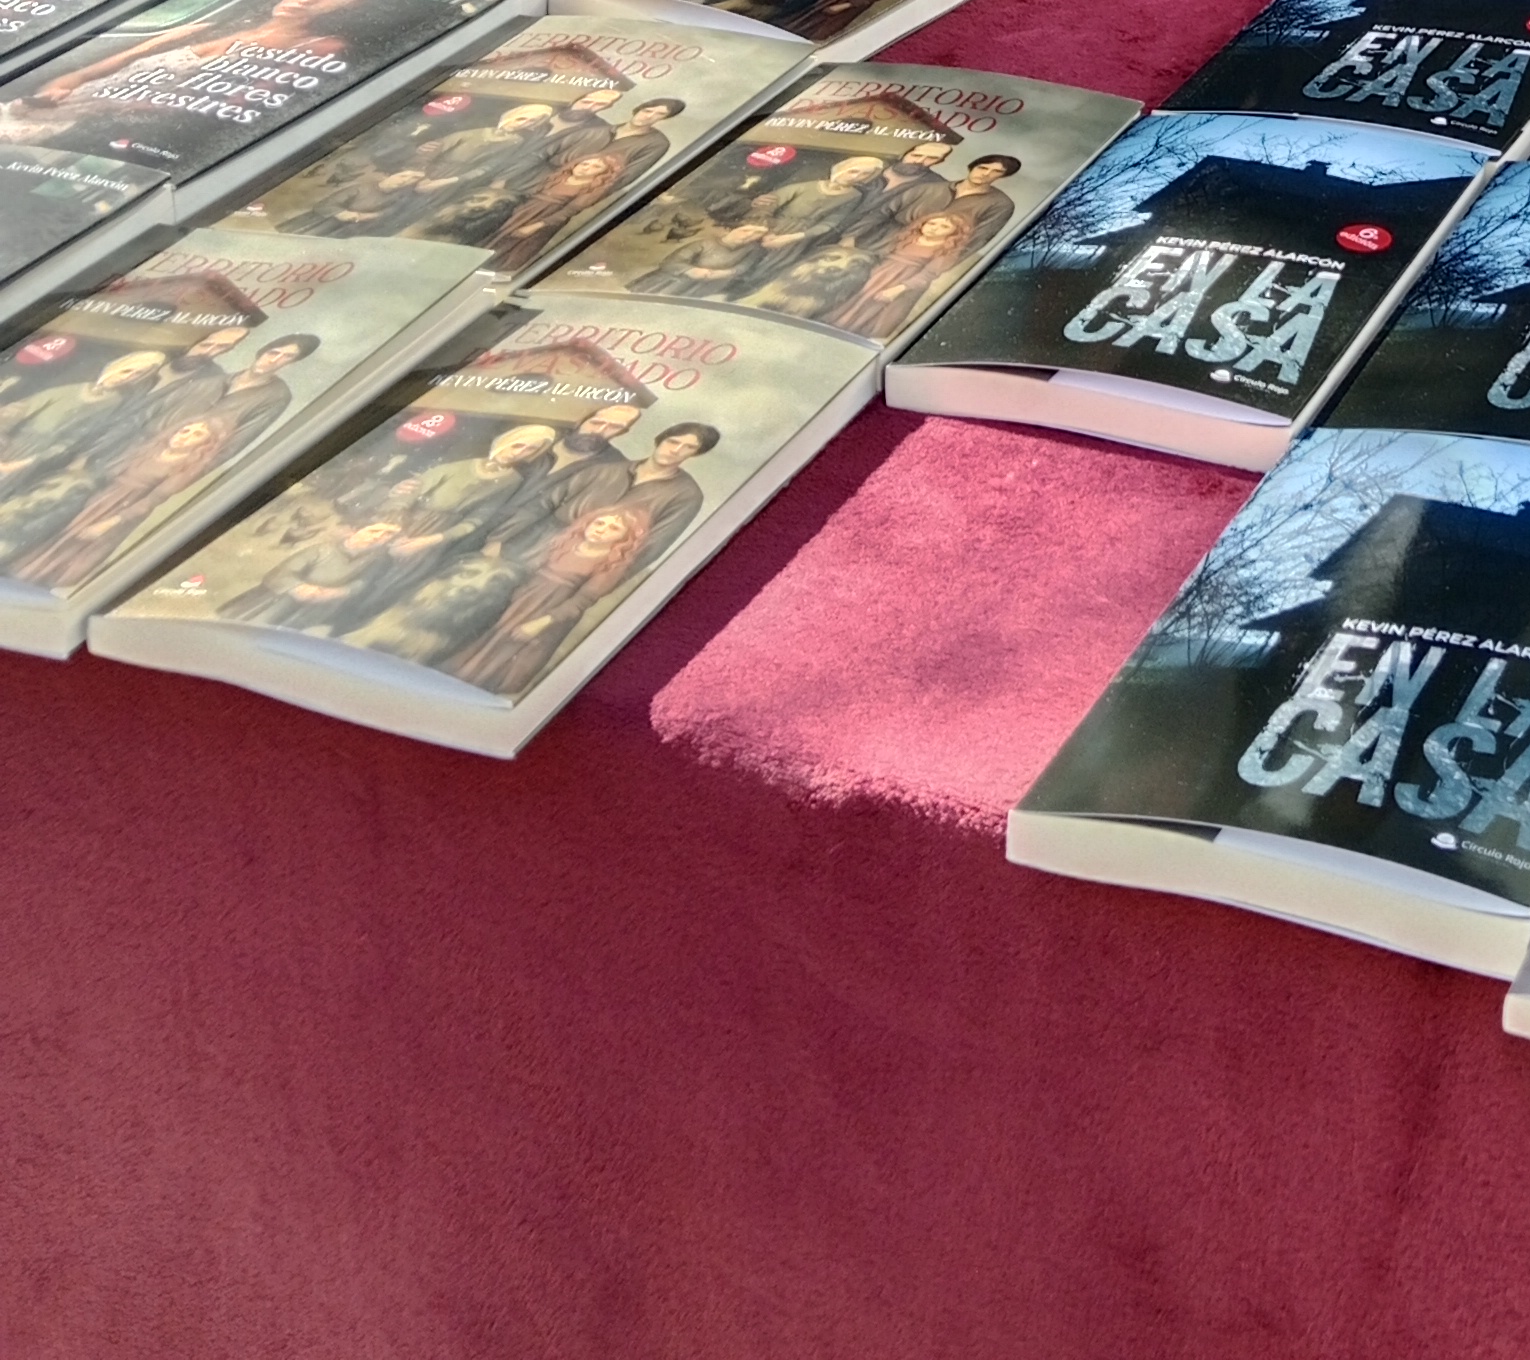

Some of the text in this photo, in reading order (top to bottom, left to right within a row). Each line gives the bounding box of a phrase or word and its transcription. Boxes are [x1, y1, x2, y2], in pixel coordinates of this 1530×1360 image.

[1372, 23, 1417, 34] KEVIN
[226, 39, 349, 75] Vestido
[1349, 31, 1443, 67] EN
[128, 67, 291, 109] de flores
[201, 56, 320, 91] blanco
[92, 82, 261, 125] silvestres
[815, 80, 1024, 116] TERRITORIO
[1302, 60, 1525, 128] CASA
[765, 116, 947, 143] KEVIN PÉREZ ALARCÓN
[1156, 236, 1345, 271] KEVIN PÉREZ ALARCÓN
[1118, 245, 1342, 312] EN LA
[1063, 284, 1325, 385] CASA
[429, 372, 637, 404] KEVIN PÉREZ ALARCÓN
[1342, 617, 1406, 637] KEVIN
[1408, 625, 1479, 649] PÉREZ
[1295, 631, 1446, 705] EN
[1460, 838, 1504, 860] Círculo
